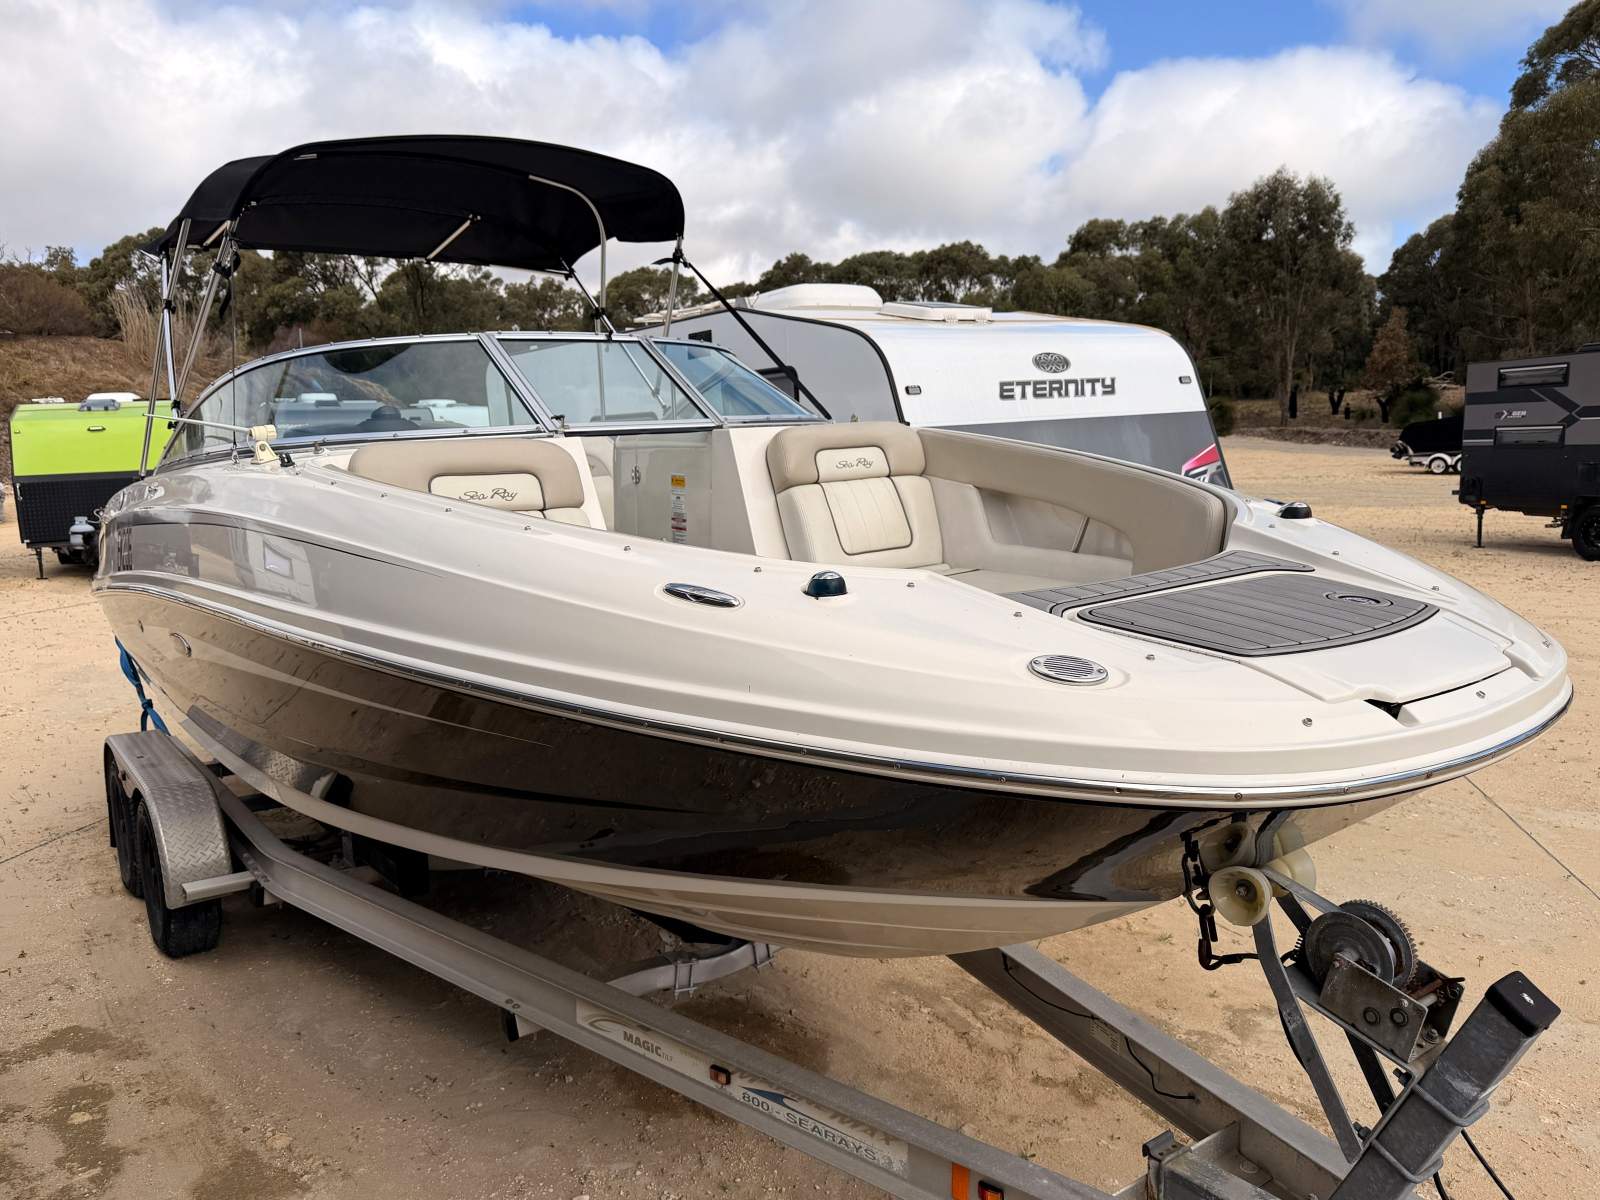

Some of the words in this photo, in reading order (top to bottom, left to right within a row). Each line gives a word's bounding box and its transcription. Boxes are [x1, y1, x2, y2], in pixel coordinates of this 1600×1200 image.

[998, 377, 1116, 400] ETERNITY
[458, 490, 488, 501] Sea
[490, 487, 518, 502] Ray
[623, 1031, 662, 1057] MAGIC
[742, 1092, 770, 1112] 800
[786, 1111, 877, 1161] SEARAYS
